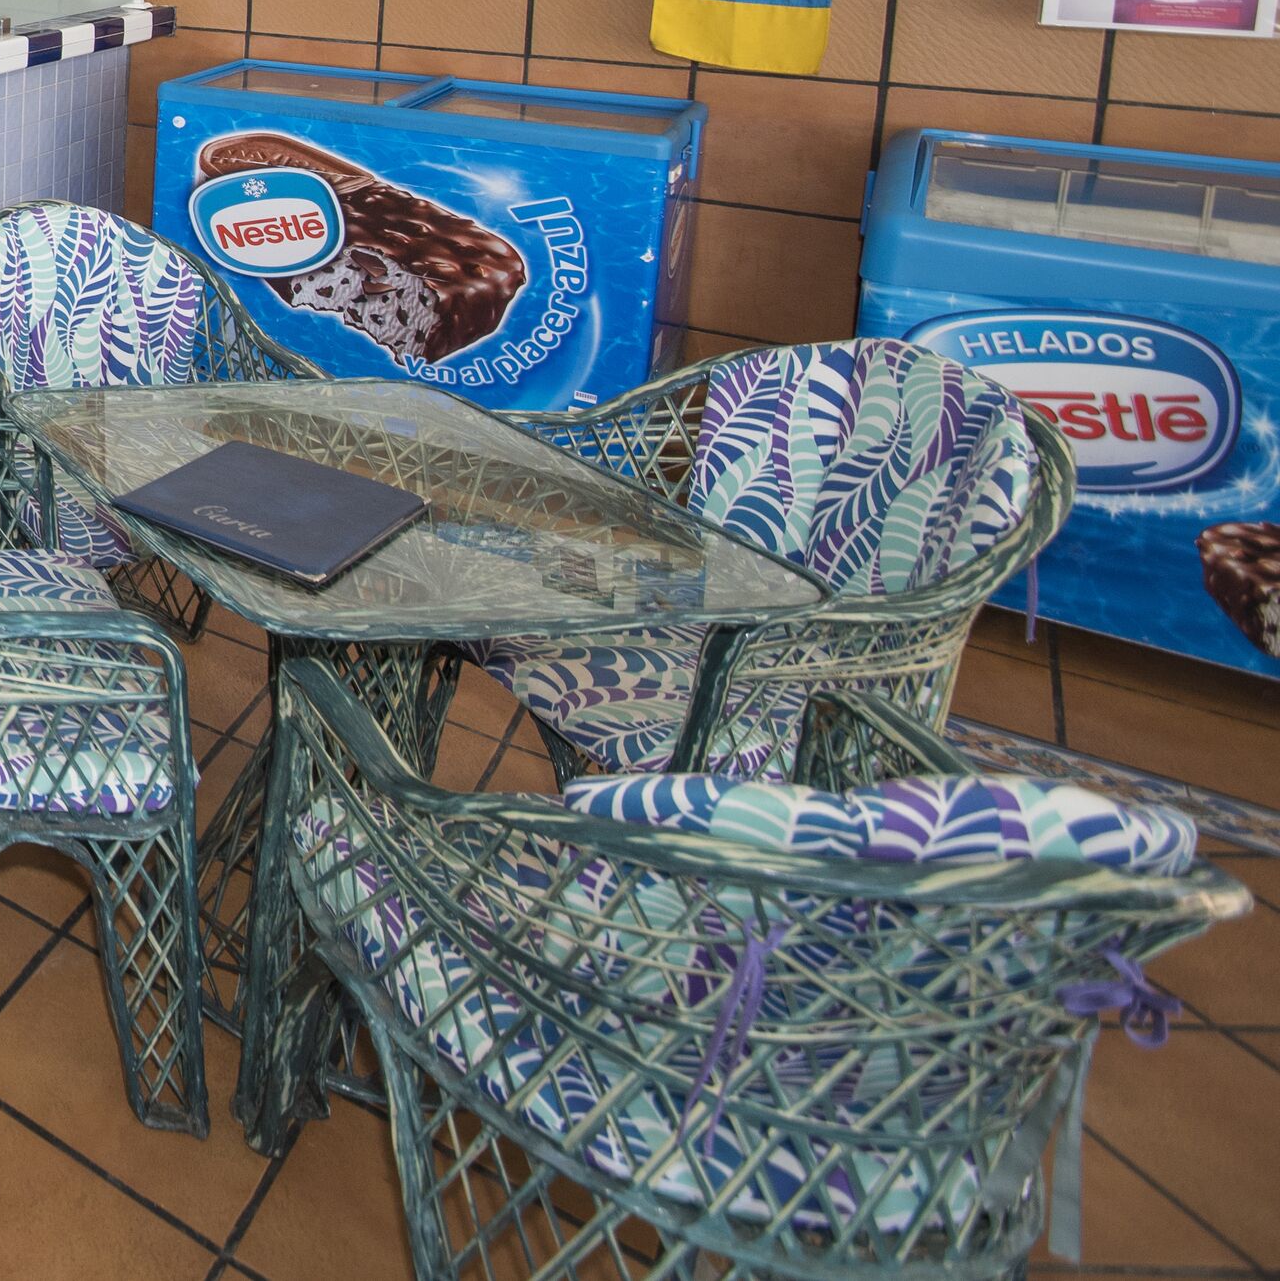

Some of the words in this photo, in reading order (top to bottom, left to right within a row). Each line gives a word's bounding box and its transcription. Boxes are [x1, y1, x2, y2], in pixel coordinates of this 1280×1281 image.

[493, 290, 579, 385] placer
[958, 329, 1157, 362] HELADOS
[404, 354, 457, 385] Ven
[461, 357, 495, 386] al
